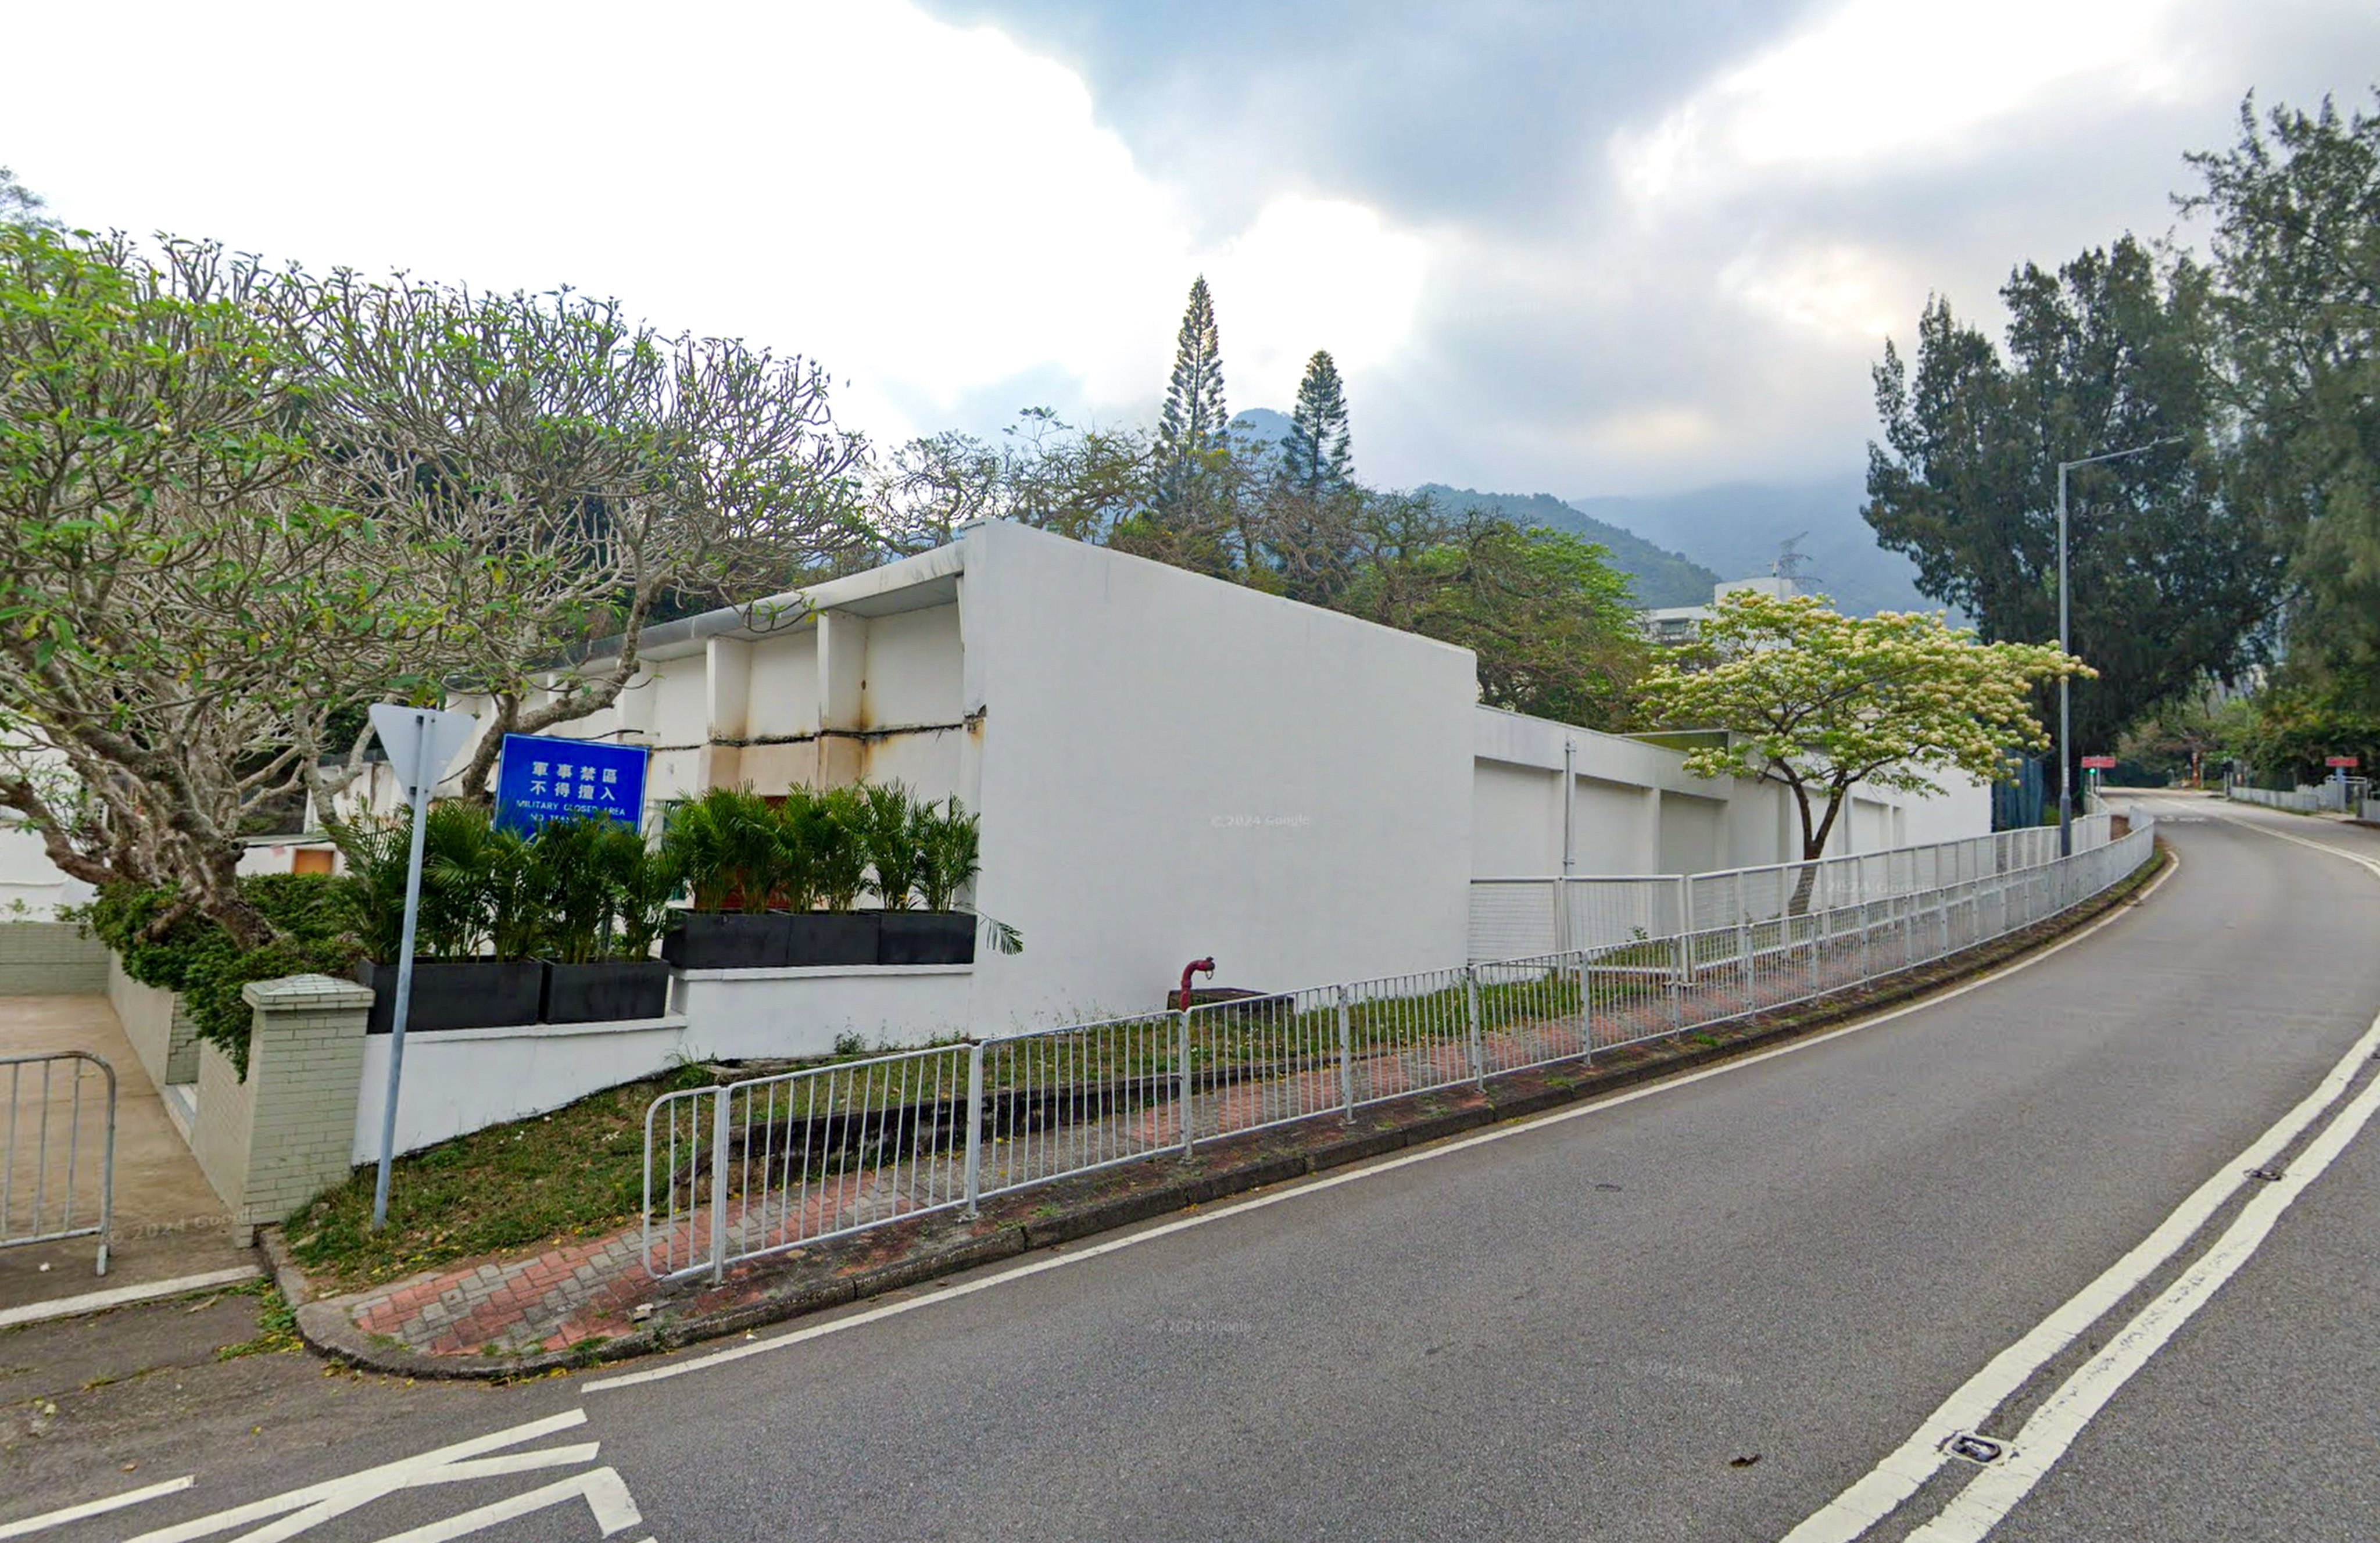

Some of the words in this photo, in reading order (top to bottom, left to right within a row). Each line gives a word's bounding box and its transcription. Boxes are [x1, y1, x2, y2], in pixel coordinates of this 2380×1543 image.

[531, 761, 617, 784] 軍事禁區
[529, 780, 615, 801] 不得擅入
[517, 800, 559, 810] MILITARY
